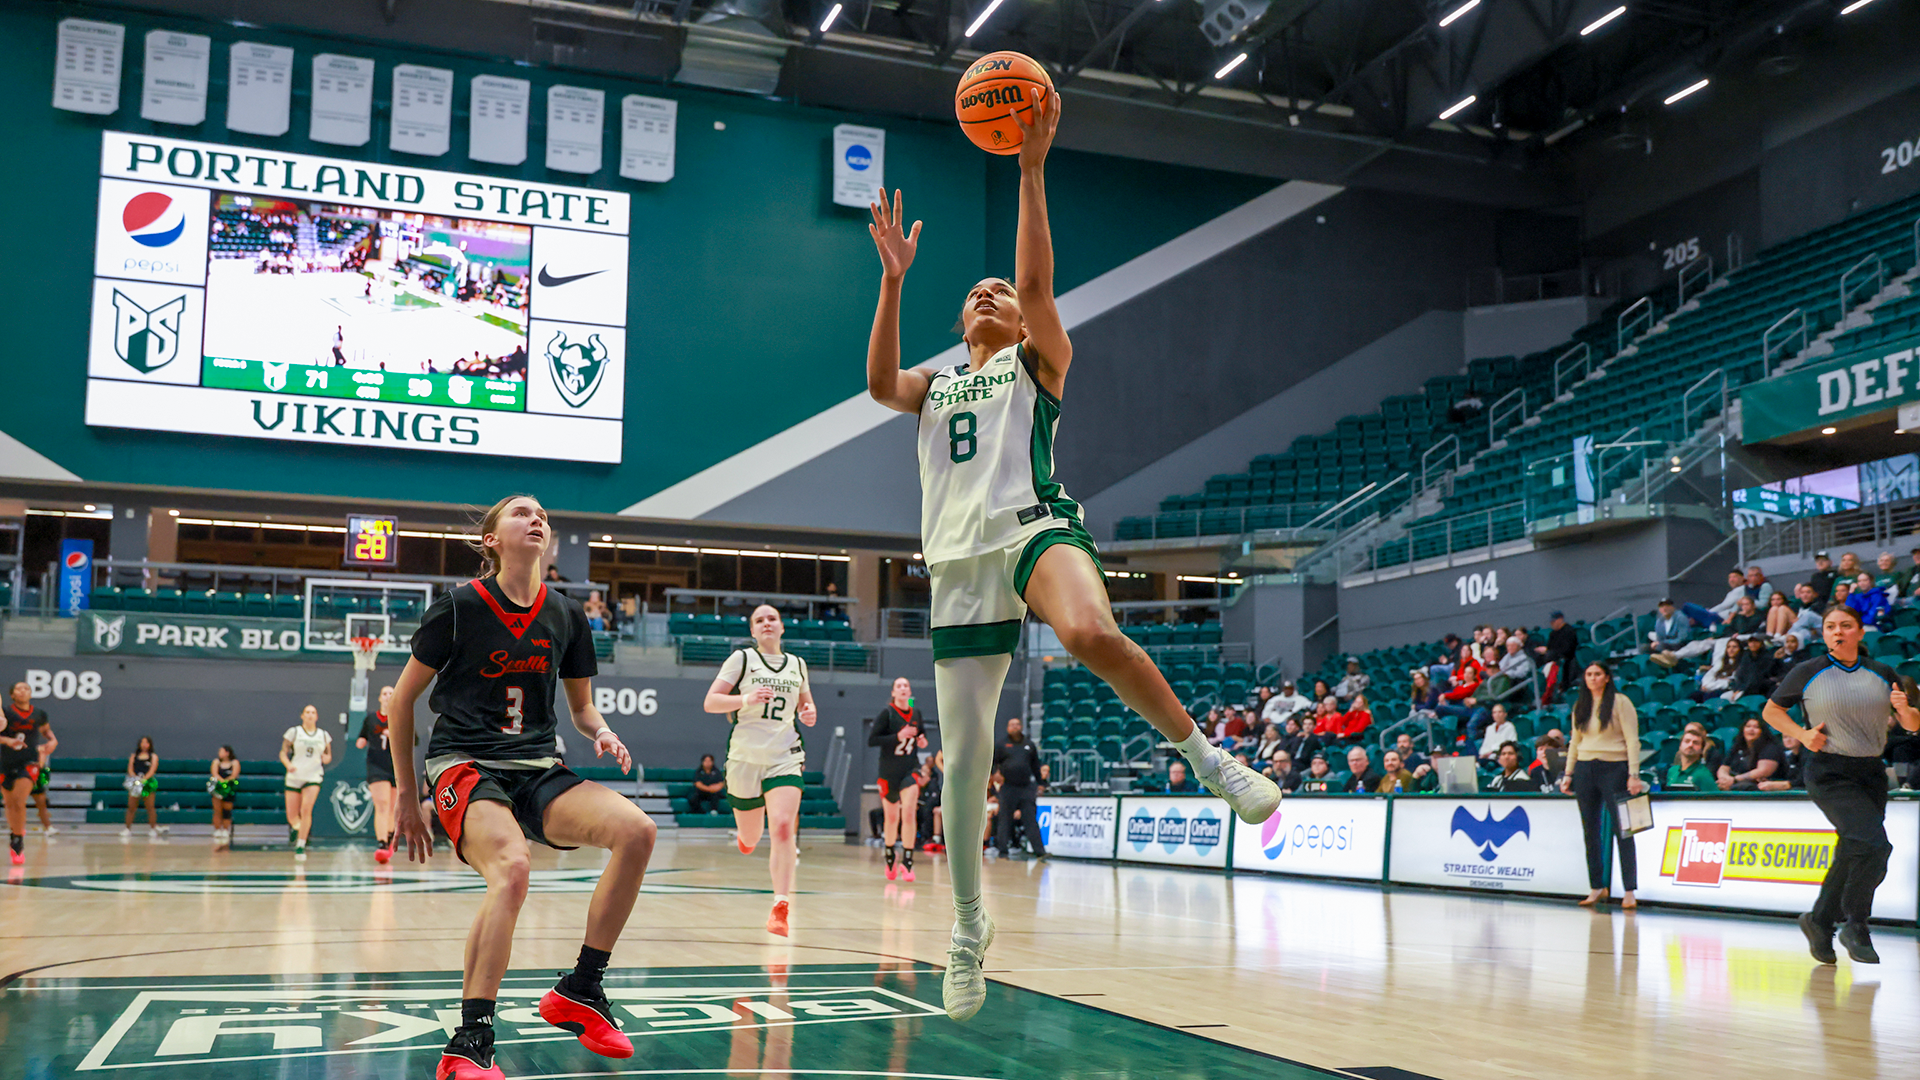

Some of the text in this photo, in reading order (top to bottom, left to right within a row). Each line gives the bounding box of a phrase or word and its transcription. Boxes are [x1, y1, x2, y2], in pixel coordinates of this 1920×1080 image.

[966, 60, 1014, 82] NCAA
[961, 86, 1025, 110] Wilson
[126, 141, 610, 226] PORTLAND STATE
[124, 258, 180, 273] pepsi
[1663, 237, 1700, 270] 205
[1817, 345, 1920, 416] DEF
[251, 399, 479, 446] VIKINGS
[948, 411, 977, 464] 8
[354, 533, 387, 560] 28
[1455, 570, 1499, 606] 104
[137, 623, 229, 649] PARK
[480, 649, 550, 678] Seattle
[25, 669, 102, 701] B08
[501, 686, 525, 735] 3
[595, 687, 658, 716] B06
[761, 696, 786, 721] 12
[1053, 805, 1113, 822] PACIFIC OFFICE
[1053, 823, 1106, 839] AUTOMATION
[1291, 818, 1354, 858] pepsi
[1681, 829, 1725, 868] Tires
[1729, 841, 1836, 869] LES SCHWA
[1443, 862, 1535, 878] STRATEGIC WEALTH
[1469, 880, 1504, 889] DESIGNERS
